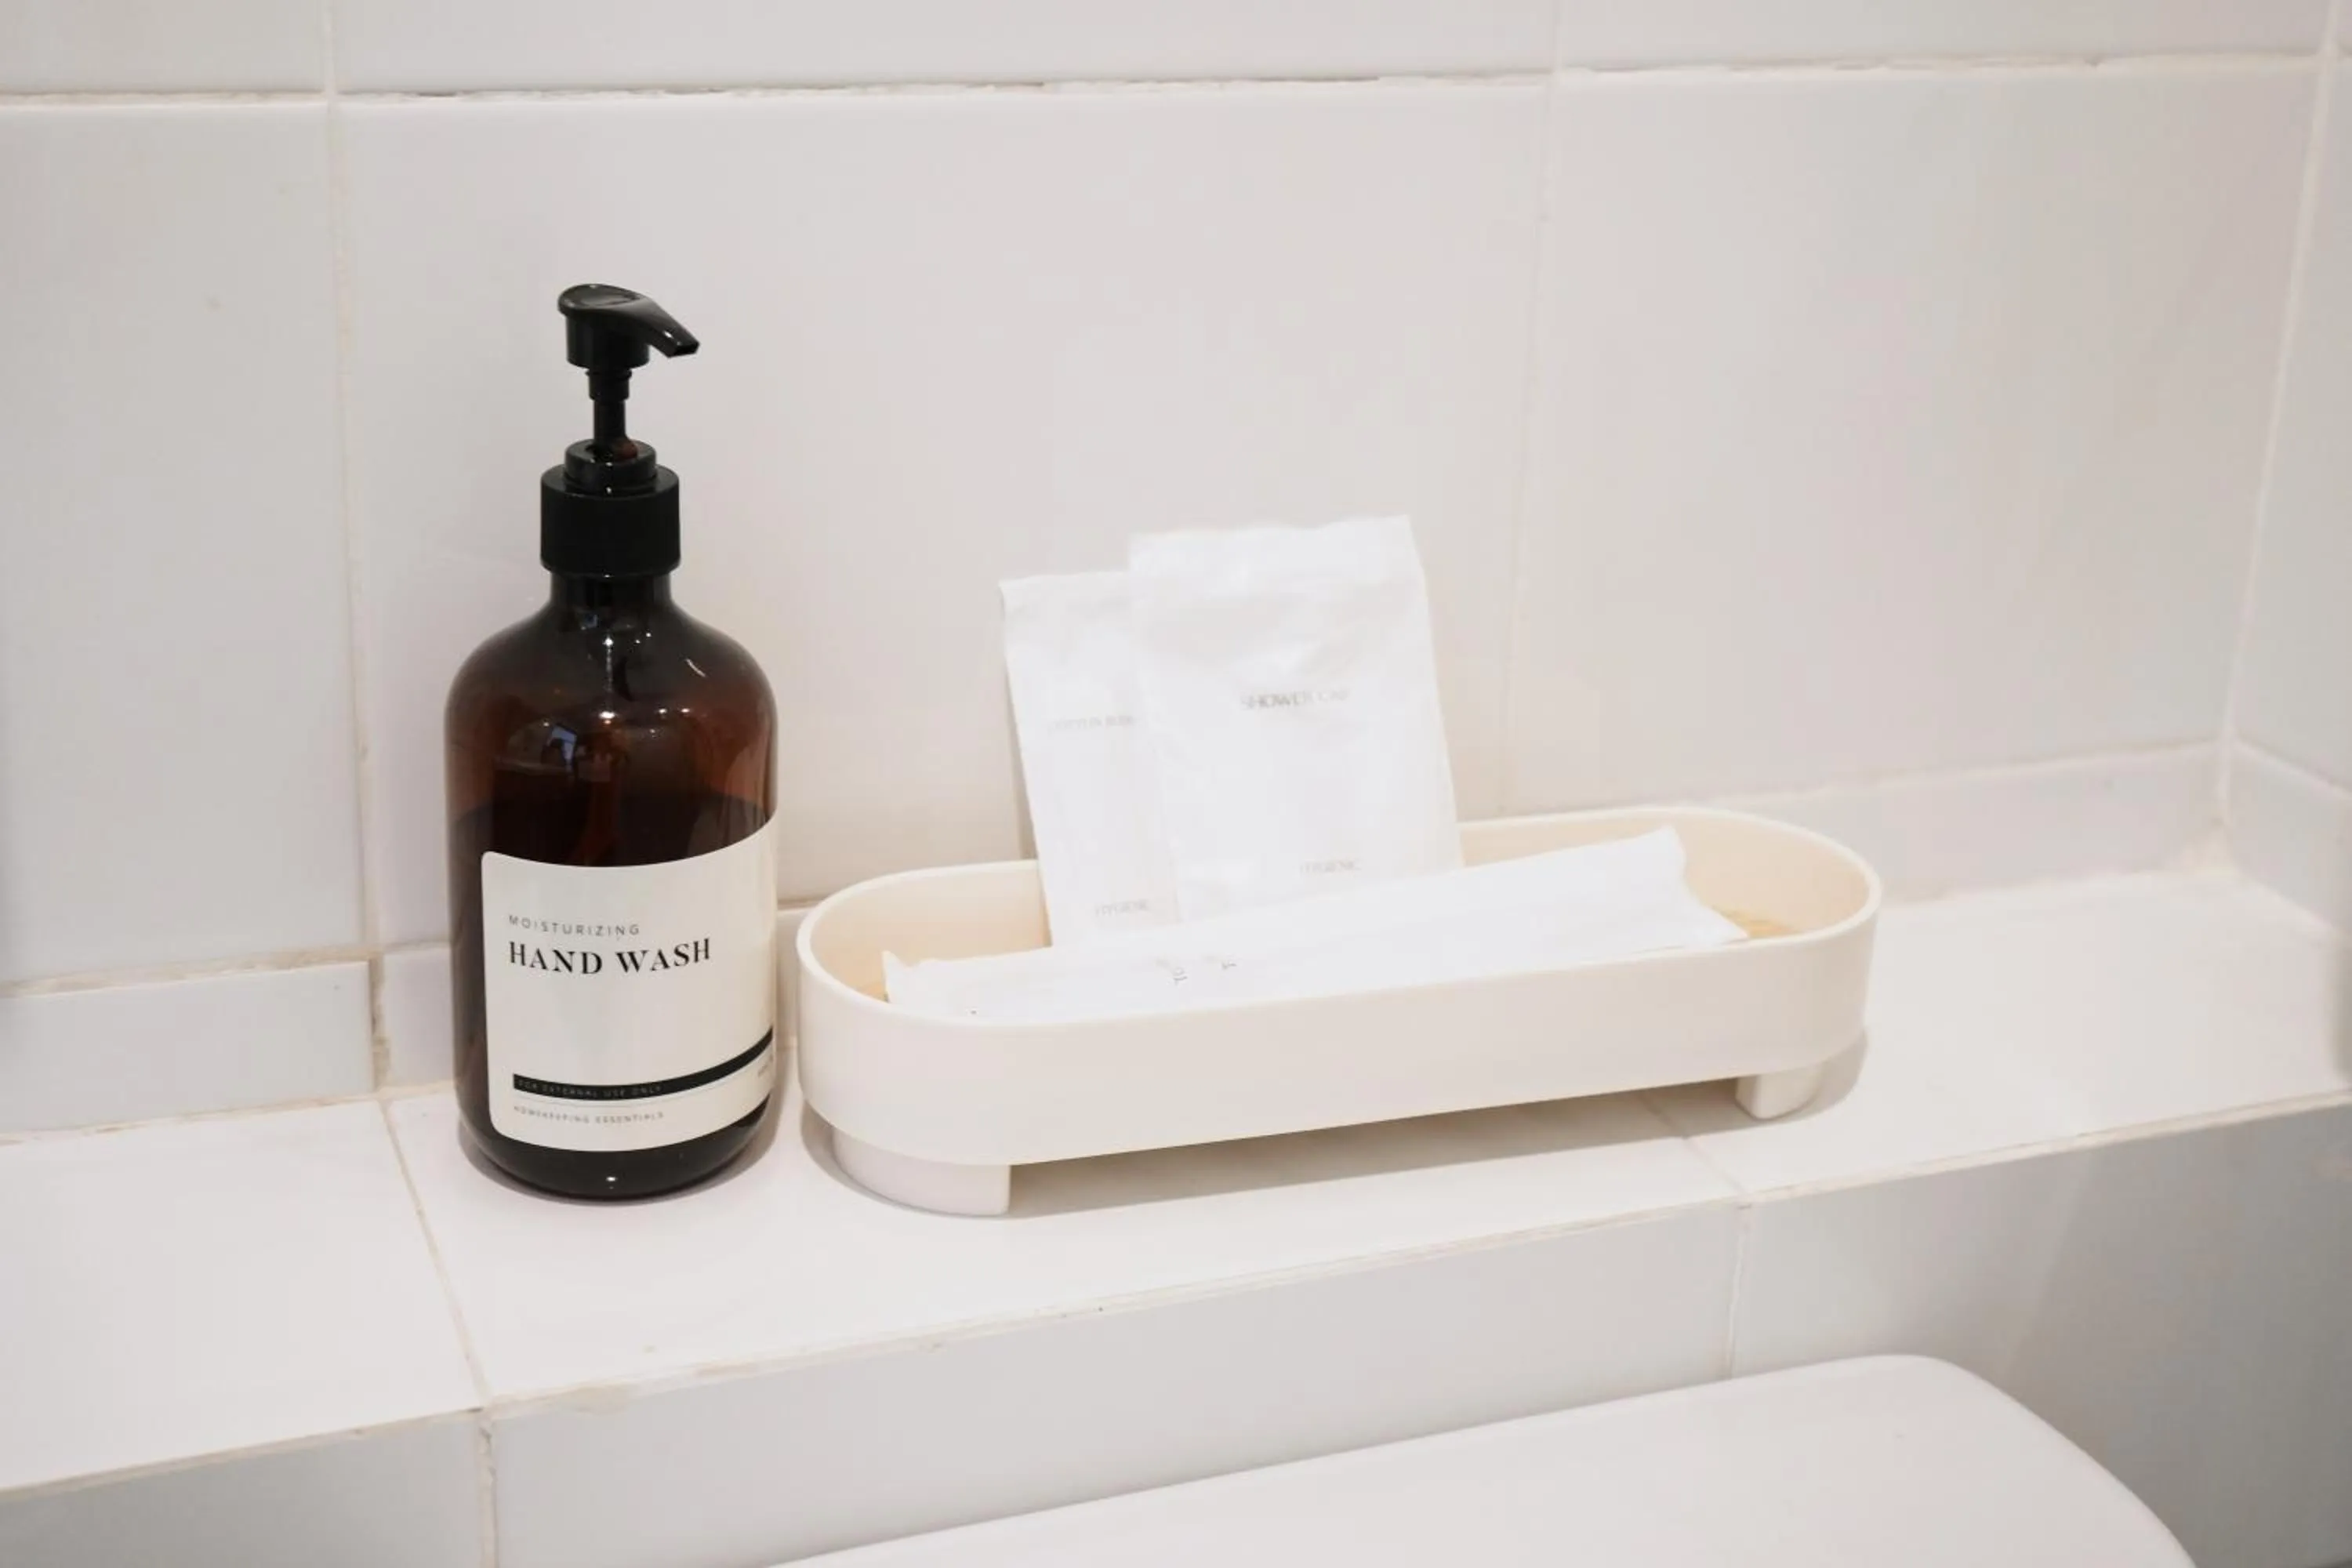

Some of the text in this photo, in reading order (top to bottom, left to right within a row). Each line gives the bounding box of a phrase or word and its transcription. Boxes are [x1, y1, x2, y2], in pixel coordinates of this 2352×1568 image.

[508, 914, 641, 937] MOISTURIZING
[509, 938, 710, 975] HAND WASH
